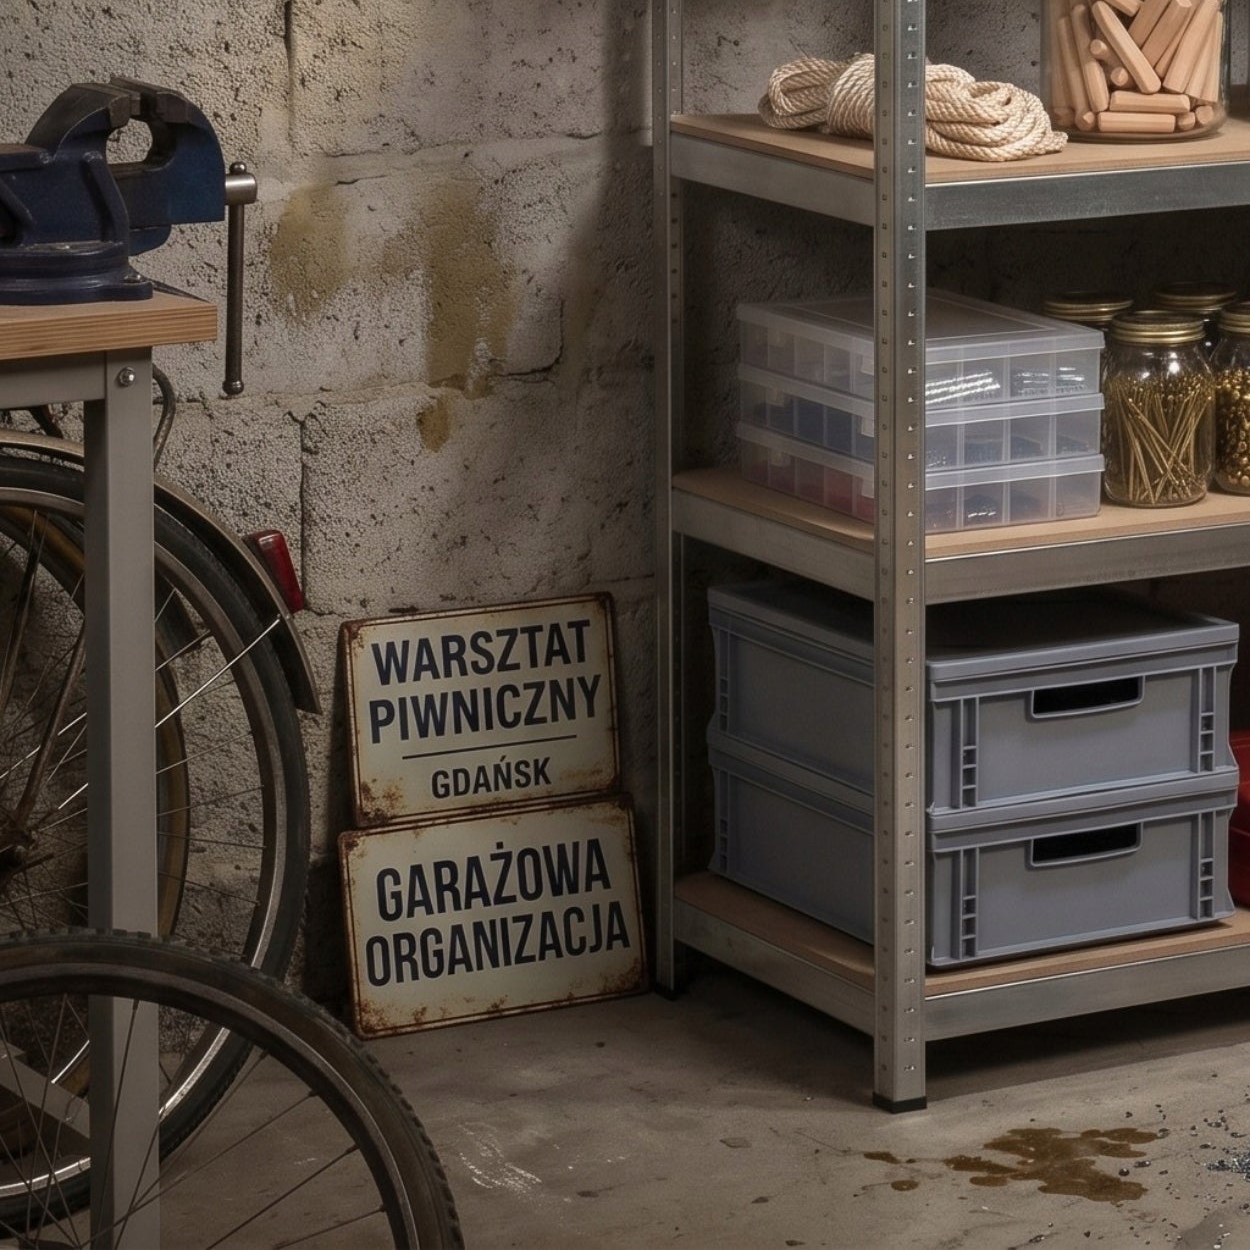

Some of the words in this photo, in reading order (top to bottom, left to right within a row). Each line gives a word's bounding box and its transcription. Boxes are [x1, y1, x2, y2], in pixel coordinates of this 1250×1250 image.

[370, 619, 591, 686] WARSZTAT
[369, 674, 601, 744] PIWNICZNY
[431, 755, 552, 799] GDAŃSK
[376, 837, 612, 922] GARAŻOWA
[365, 900, 631, 987] ORGANIZACJA
